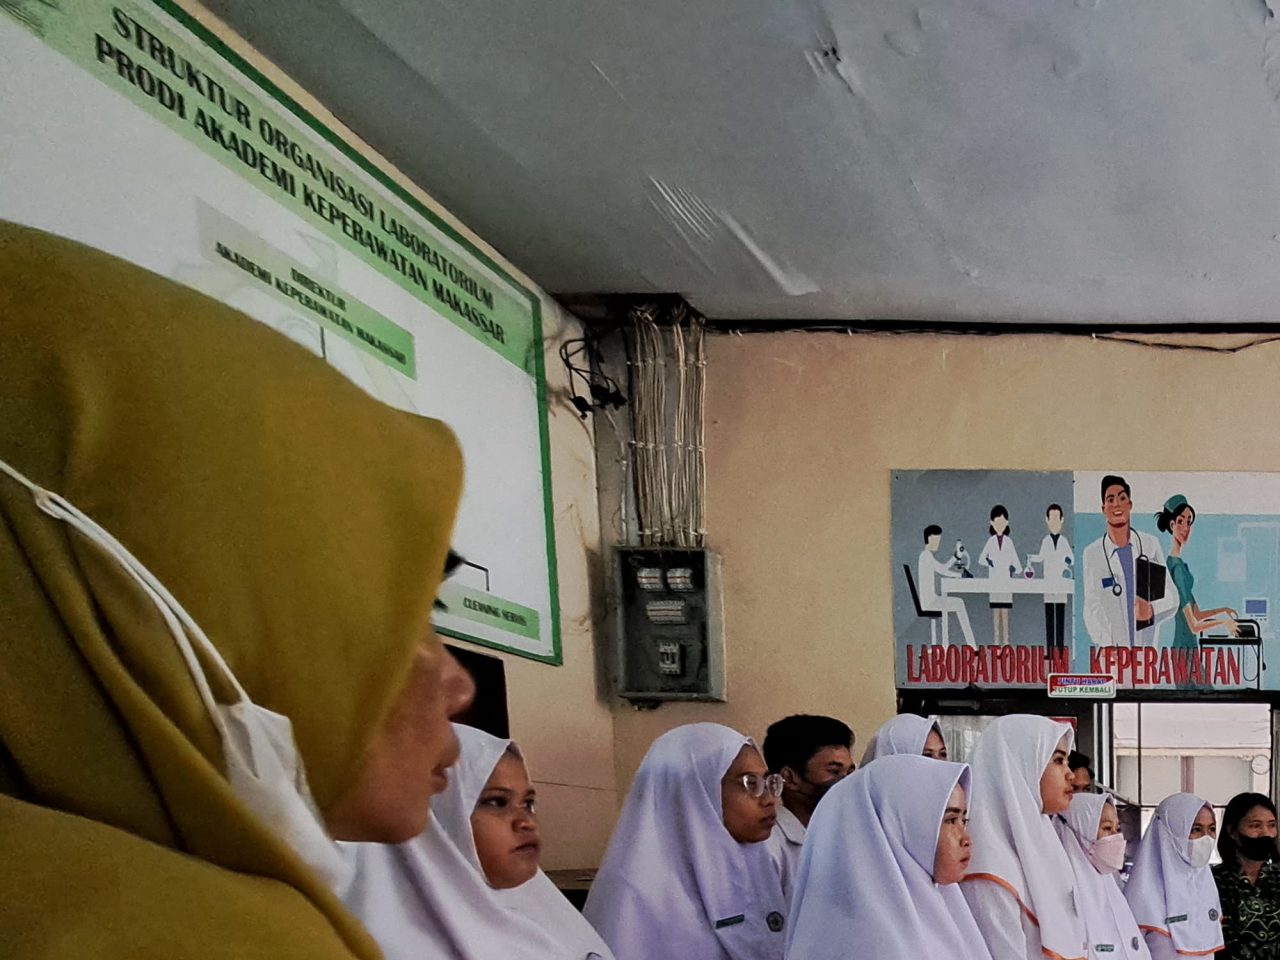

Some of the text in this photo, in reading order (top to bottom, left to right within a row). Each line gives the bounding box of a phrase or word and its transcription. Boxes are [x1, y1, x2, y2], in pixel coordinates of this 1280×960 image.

[94, 32, 507, 346] PRODI AKADEMI KEPERAWATAN MAKASSAR
[112, 6, 495, 311] STRUKTUR ORGANISASI LABORATORIUM
[906, 643, 1242, 686] LABORATORIUM KEPERAWATAN
